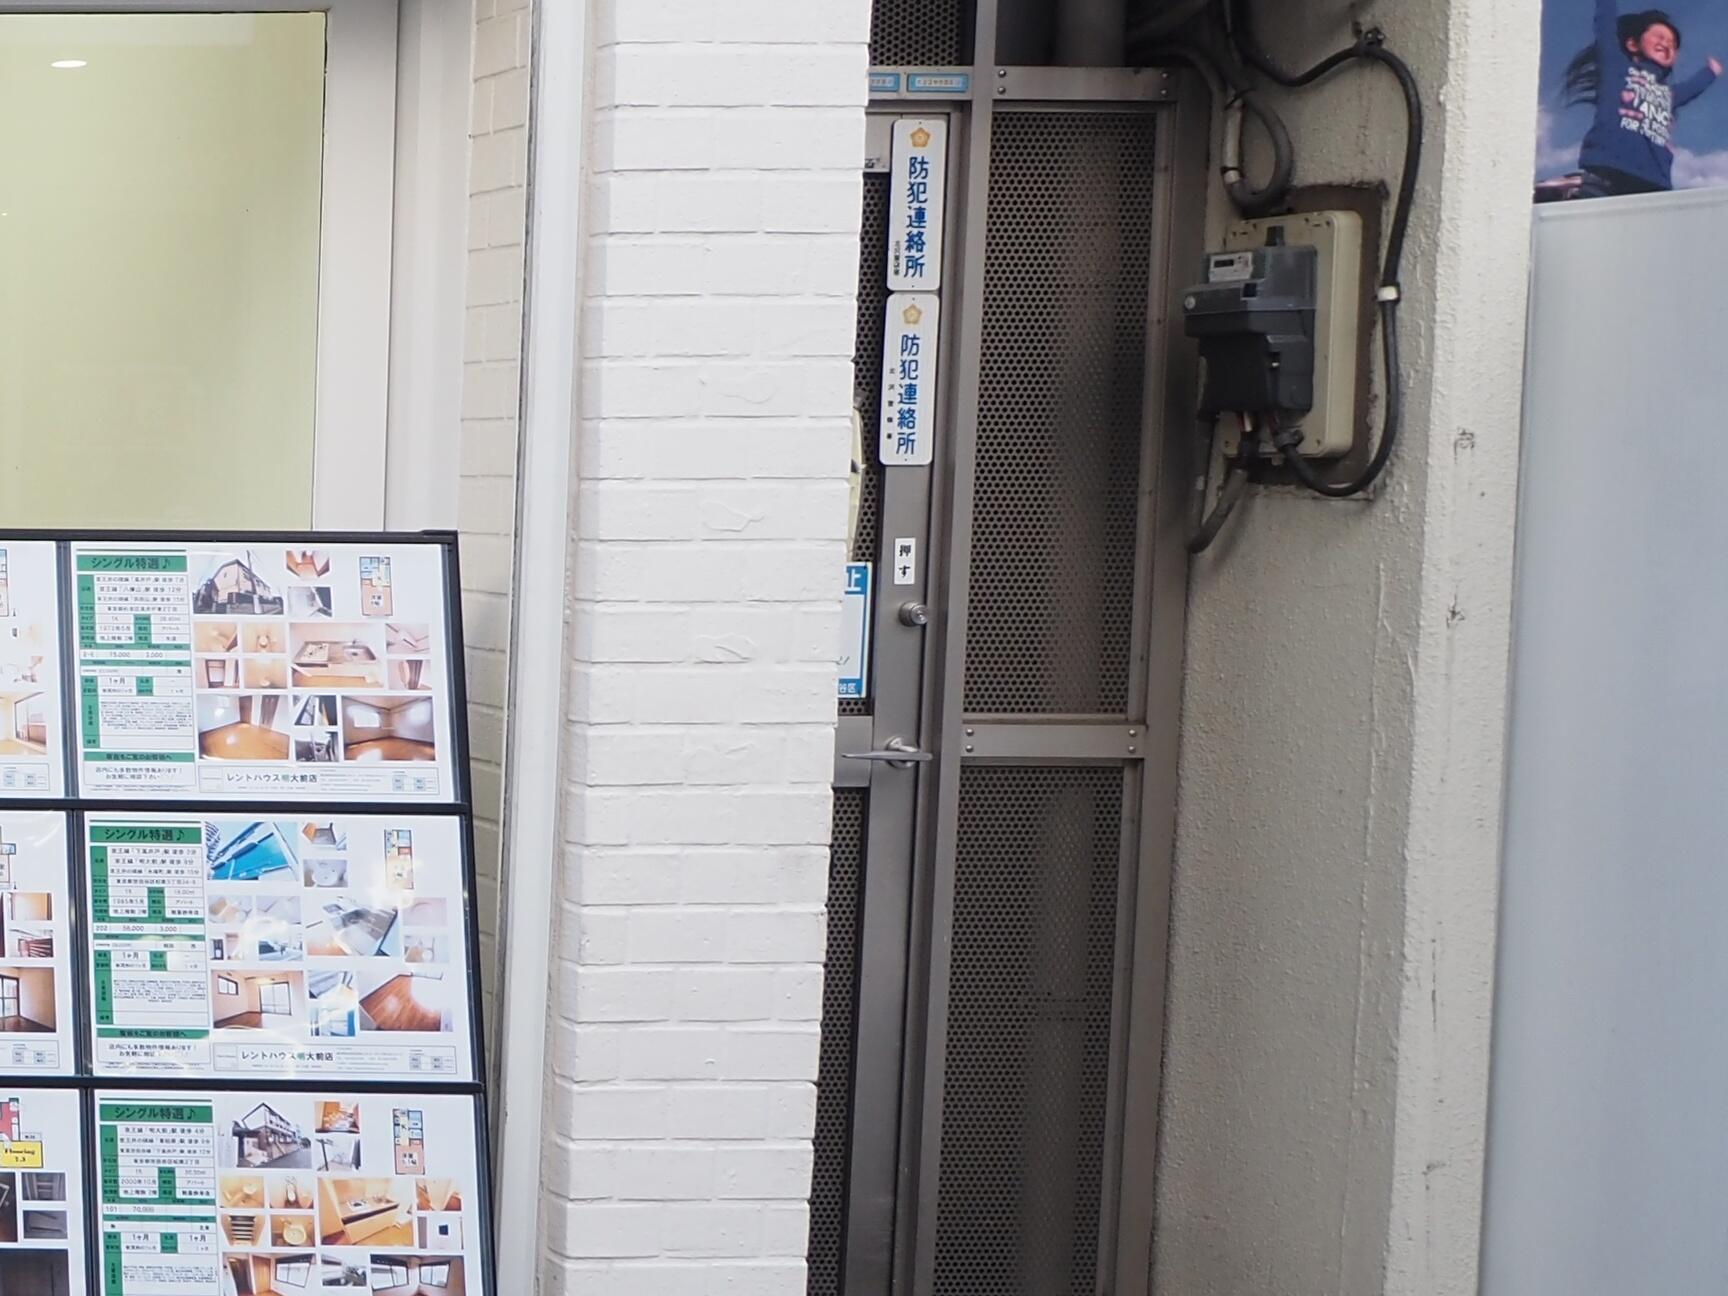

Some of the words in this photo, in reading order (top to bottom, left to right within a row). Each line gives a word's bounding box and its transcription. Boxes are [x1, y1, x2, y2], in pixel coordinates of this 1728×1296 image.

[903, 155, 930, 279] 防犯連絡所
[895, 333, 921, 456] 防犯連絡所
[898, 544, 912, 578] 押す
